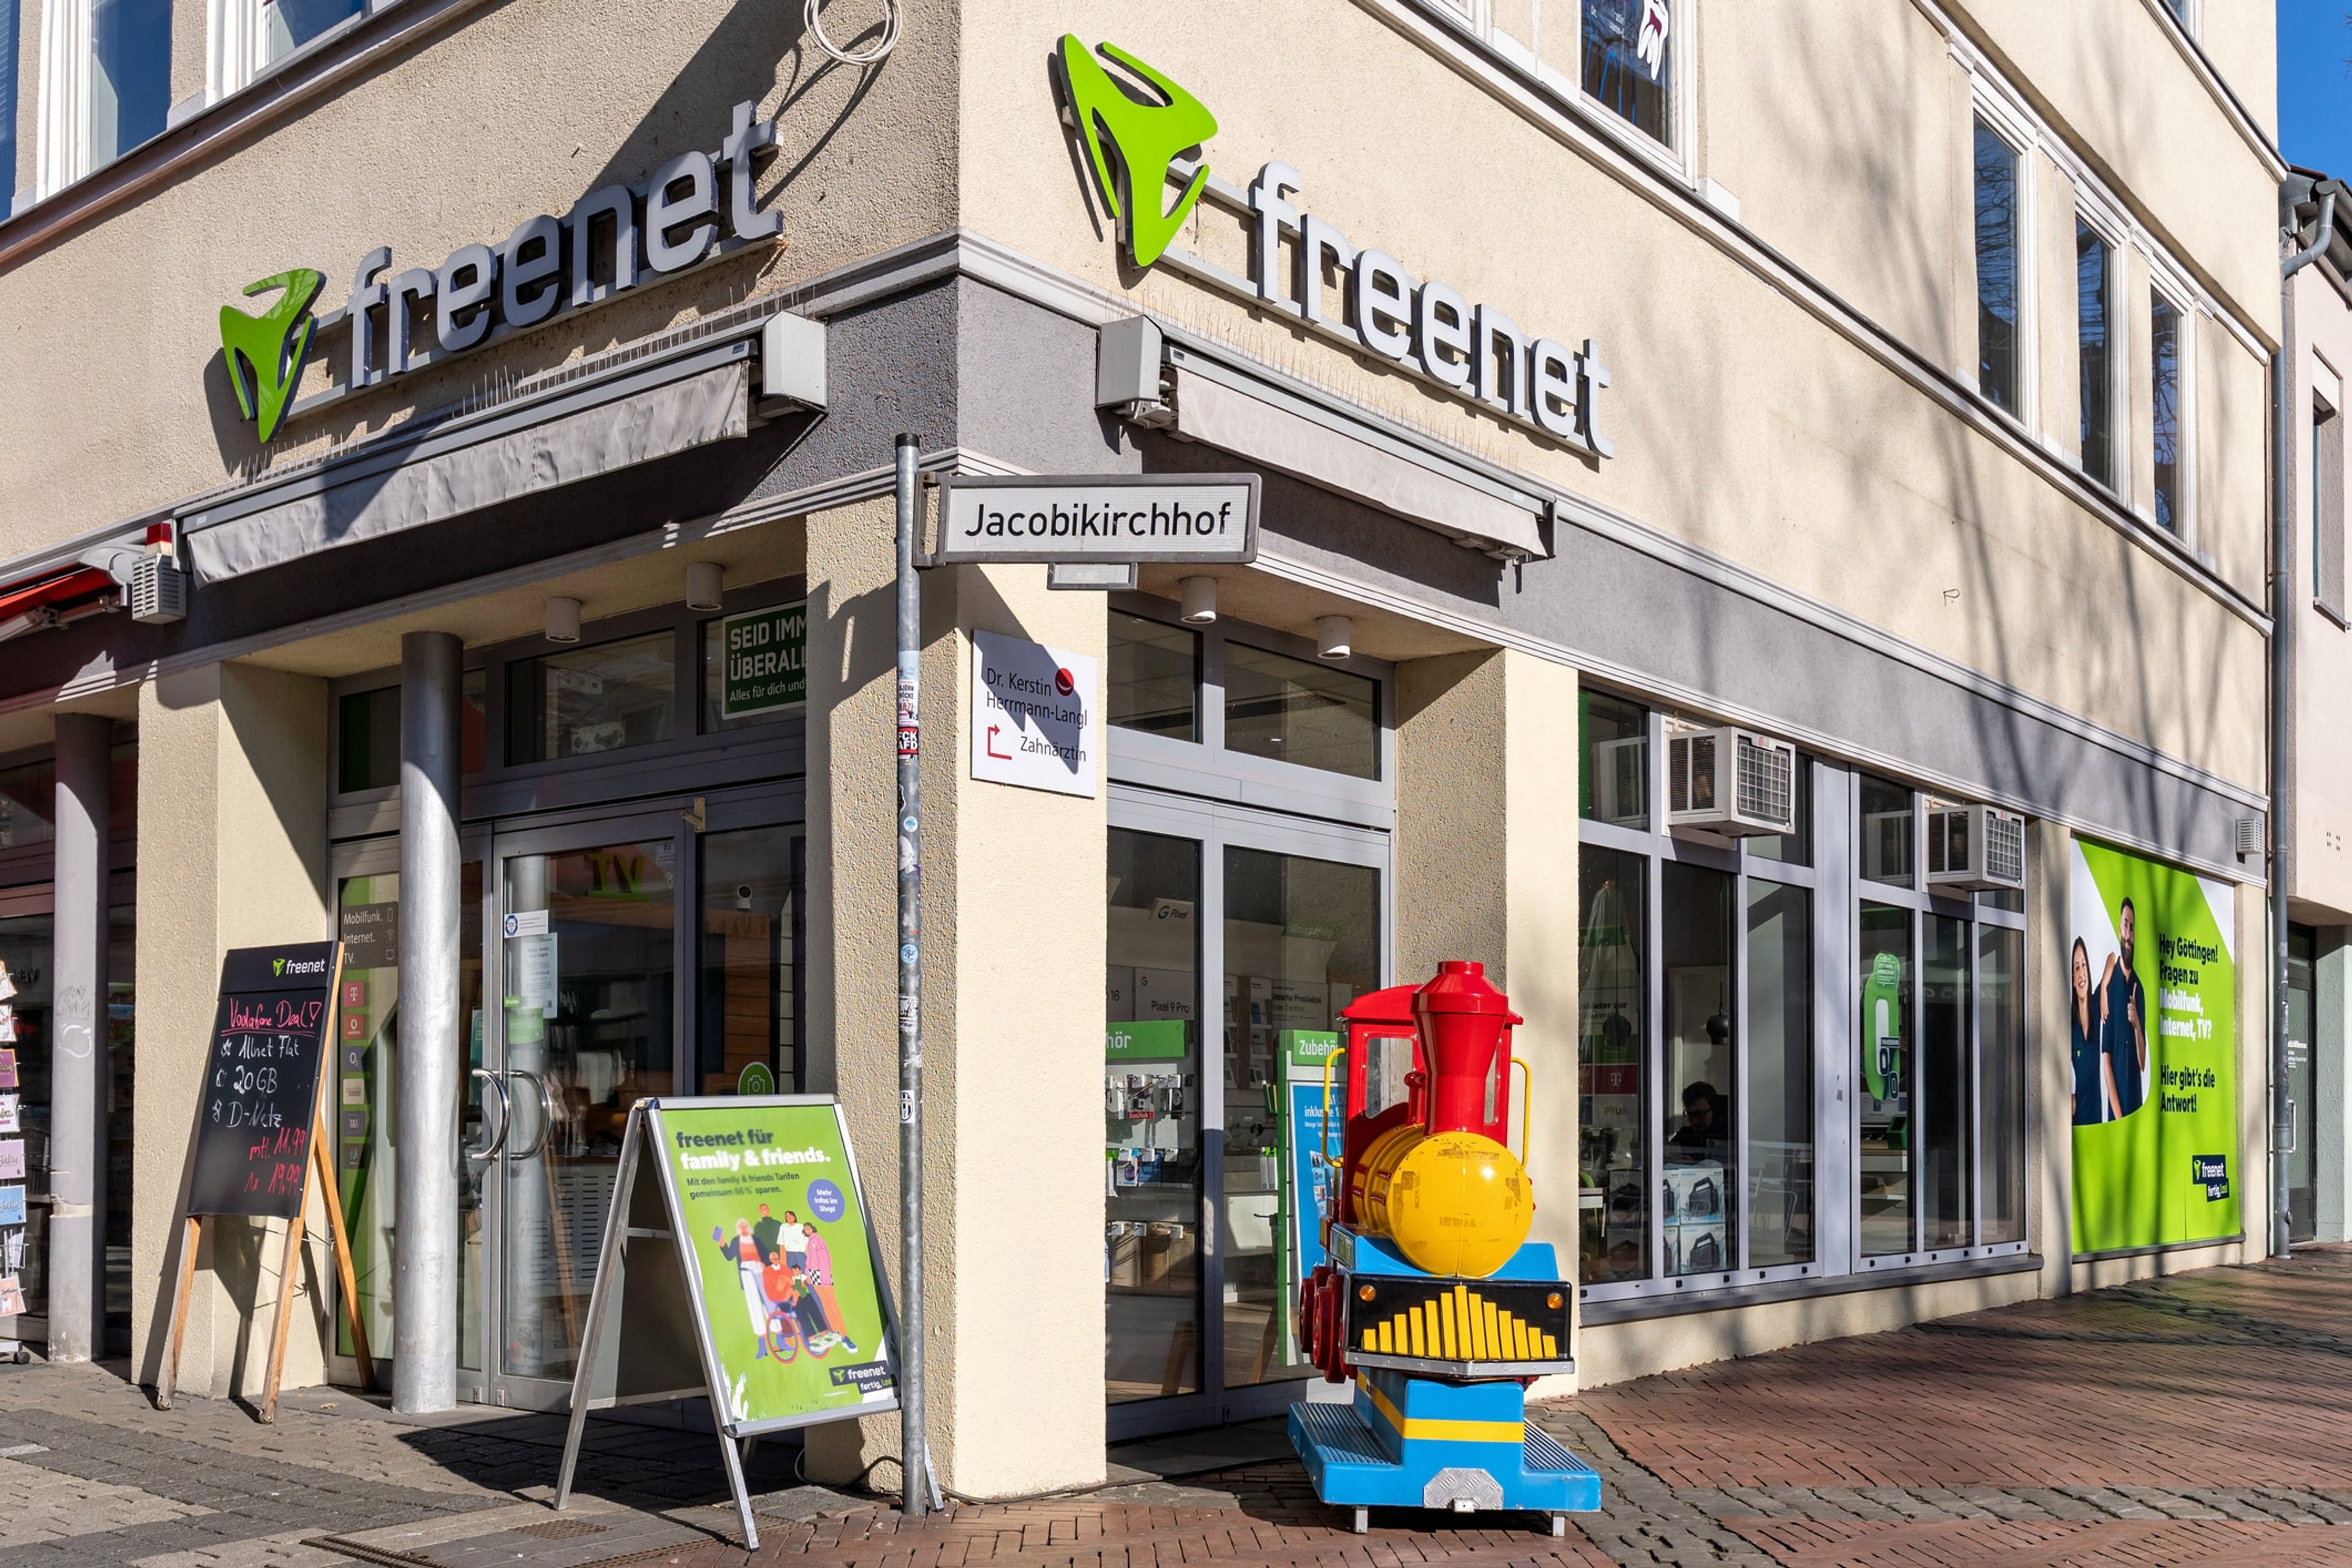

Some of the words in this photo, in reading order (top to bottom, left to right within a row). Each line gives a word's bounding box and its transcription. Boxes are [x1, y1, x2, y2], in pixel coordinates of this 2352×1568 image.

[347, 100, 783, 389] freenet
[1249, 159, 1615, 459] freenet
[965, 502, 1231, 537] Jacobikirchhof
[730, 622, 769, 650] SEID
[729, 687, 751, 703] Alles
[752, 684, 765, 698] für
[767, 680, 785, 695] dich
[788, 677, 805, 692] und
[987, 668, 1004, 687] Dr.
[1009, 673, 1052, 697] Kerstin
[987, 691, 1088, 729] Herrmann-Langl
[1020, 736, 1087, 762] Zahnärztin
[344, 910, 383, 925] Mobilfunk.
[1170, 909, 1189, 919] Pixel
[344, 932, 375, 944] Internet.
[2159, 933, 2176, 960] Hey
[2176, 937, 2218, 966] Göttingen!
[286, 959, 326, 974] freenet
[344, 952, 355, 965] TV.
[2159, 960, 2188, 987] Fragen
[2189, 970, 2199, 986] zu
[1110, 990, 1120, 1001] 16
[1151, 1000, 1169, 1012] Pixel
[1170, 1002, 1175, 1011] 9
[1176, 1003, 1189, 1014] Pro
[2160, 987, 2204, 1017] Mobilfunk,
[2160, 1014, 2196, 1042] Internet,
[2196, 1018, 2212, 1039] TV?
[279, 1035, 300, 1058] Flat
[2160, 1065, 2178, 1085] Hier
[2203, 1068, 2215, 1088] die
[227, 1099, 282, 1128] D-Netz
[2160, 1091, 2197, 1113] Antwort!
[676, 1131, 745, 1148] freenet
[747, 1129, 774, 1144] für
[680, 1150, 740, 1172] family
[744, 1149, 760, 1166] &
[761, 1147, 831, 1165] friends.
[2202, 1162, 2225, 1178] freenet
[687, 1177, 699, 1186] Mit
[701, 1176, 715, 1185] den
[717, 1174, 739, 1185] family
[748, 1172, 774, 1182] friends
[690, 1189, 733, 1200] gemeinsam
[755, 1185, 782, 1195] sparen.
[847, 1365, 887, 1381] freenet
